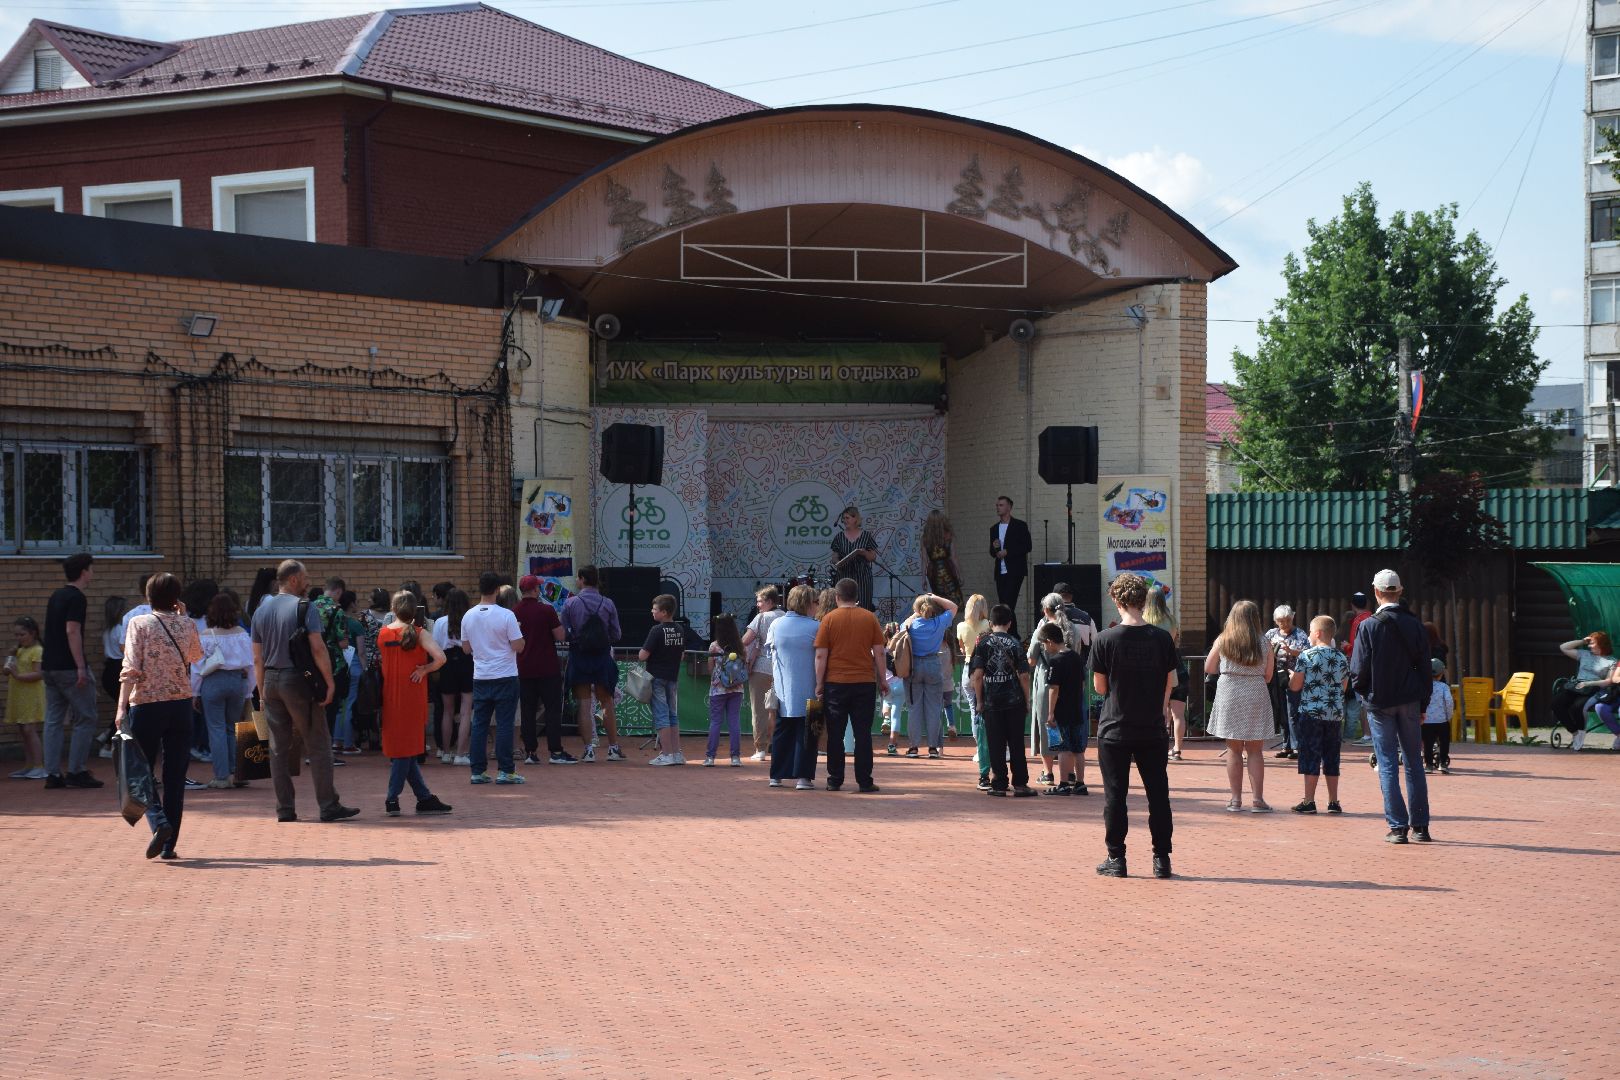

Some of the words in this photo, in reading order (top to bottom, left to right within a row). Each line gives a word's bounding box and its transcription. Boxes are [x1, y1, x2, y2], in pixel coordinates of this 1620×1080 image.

[652, 360, 713, 384] «Парк
[719, 364, 813, 384] культуры
[820, 365, 832, 381] и
[838, 365, 920, 384] отдыха»
[784, 526, 832, 537] лето
